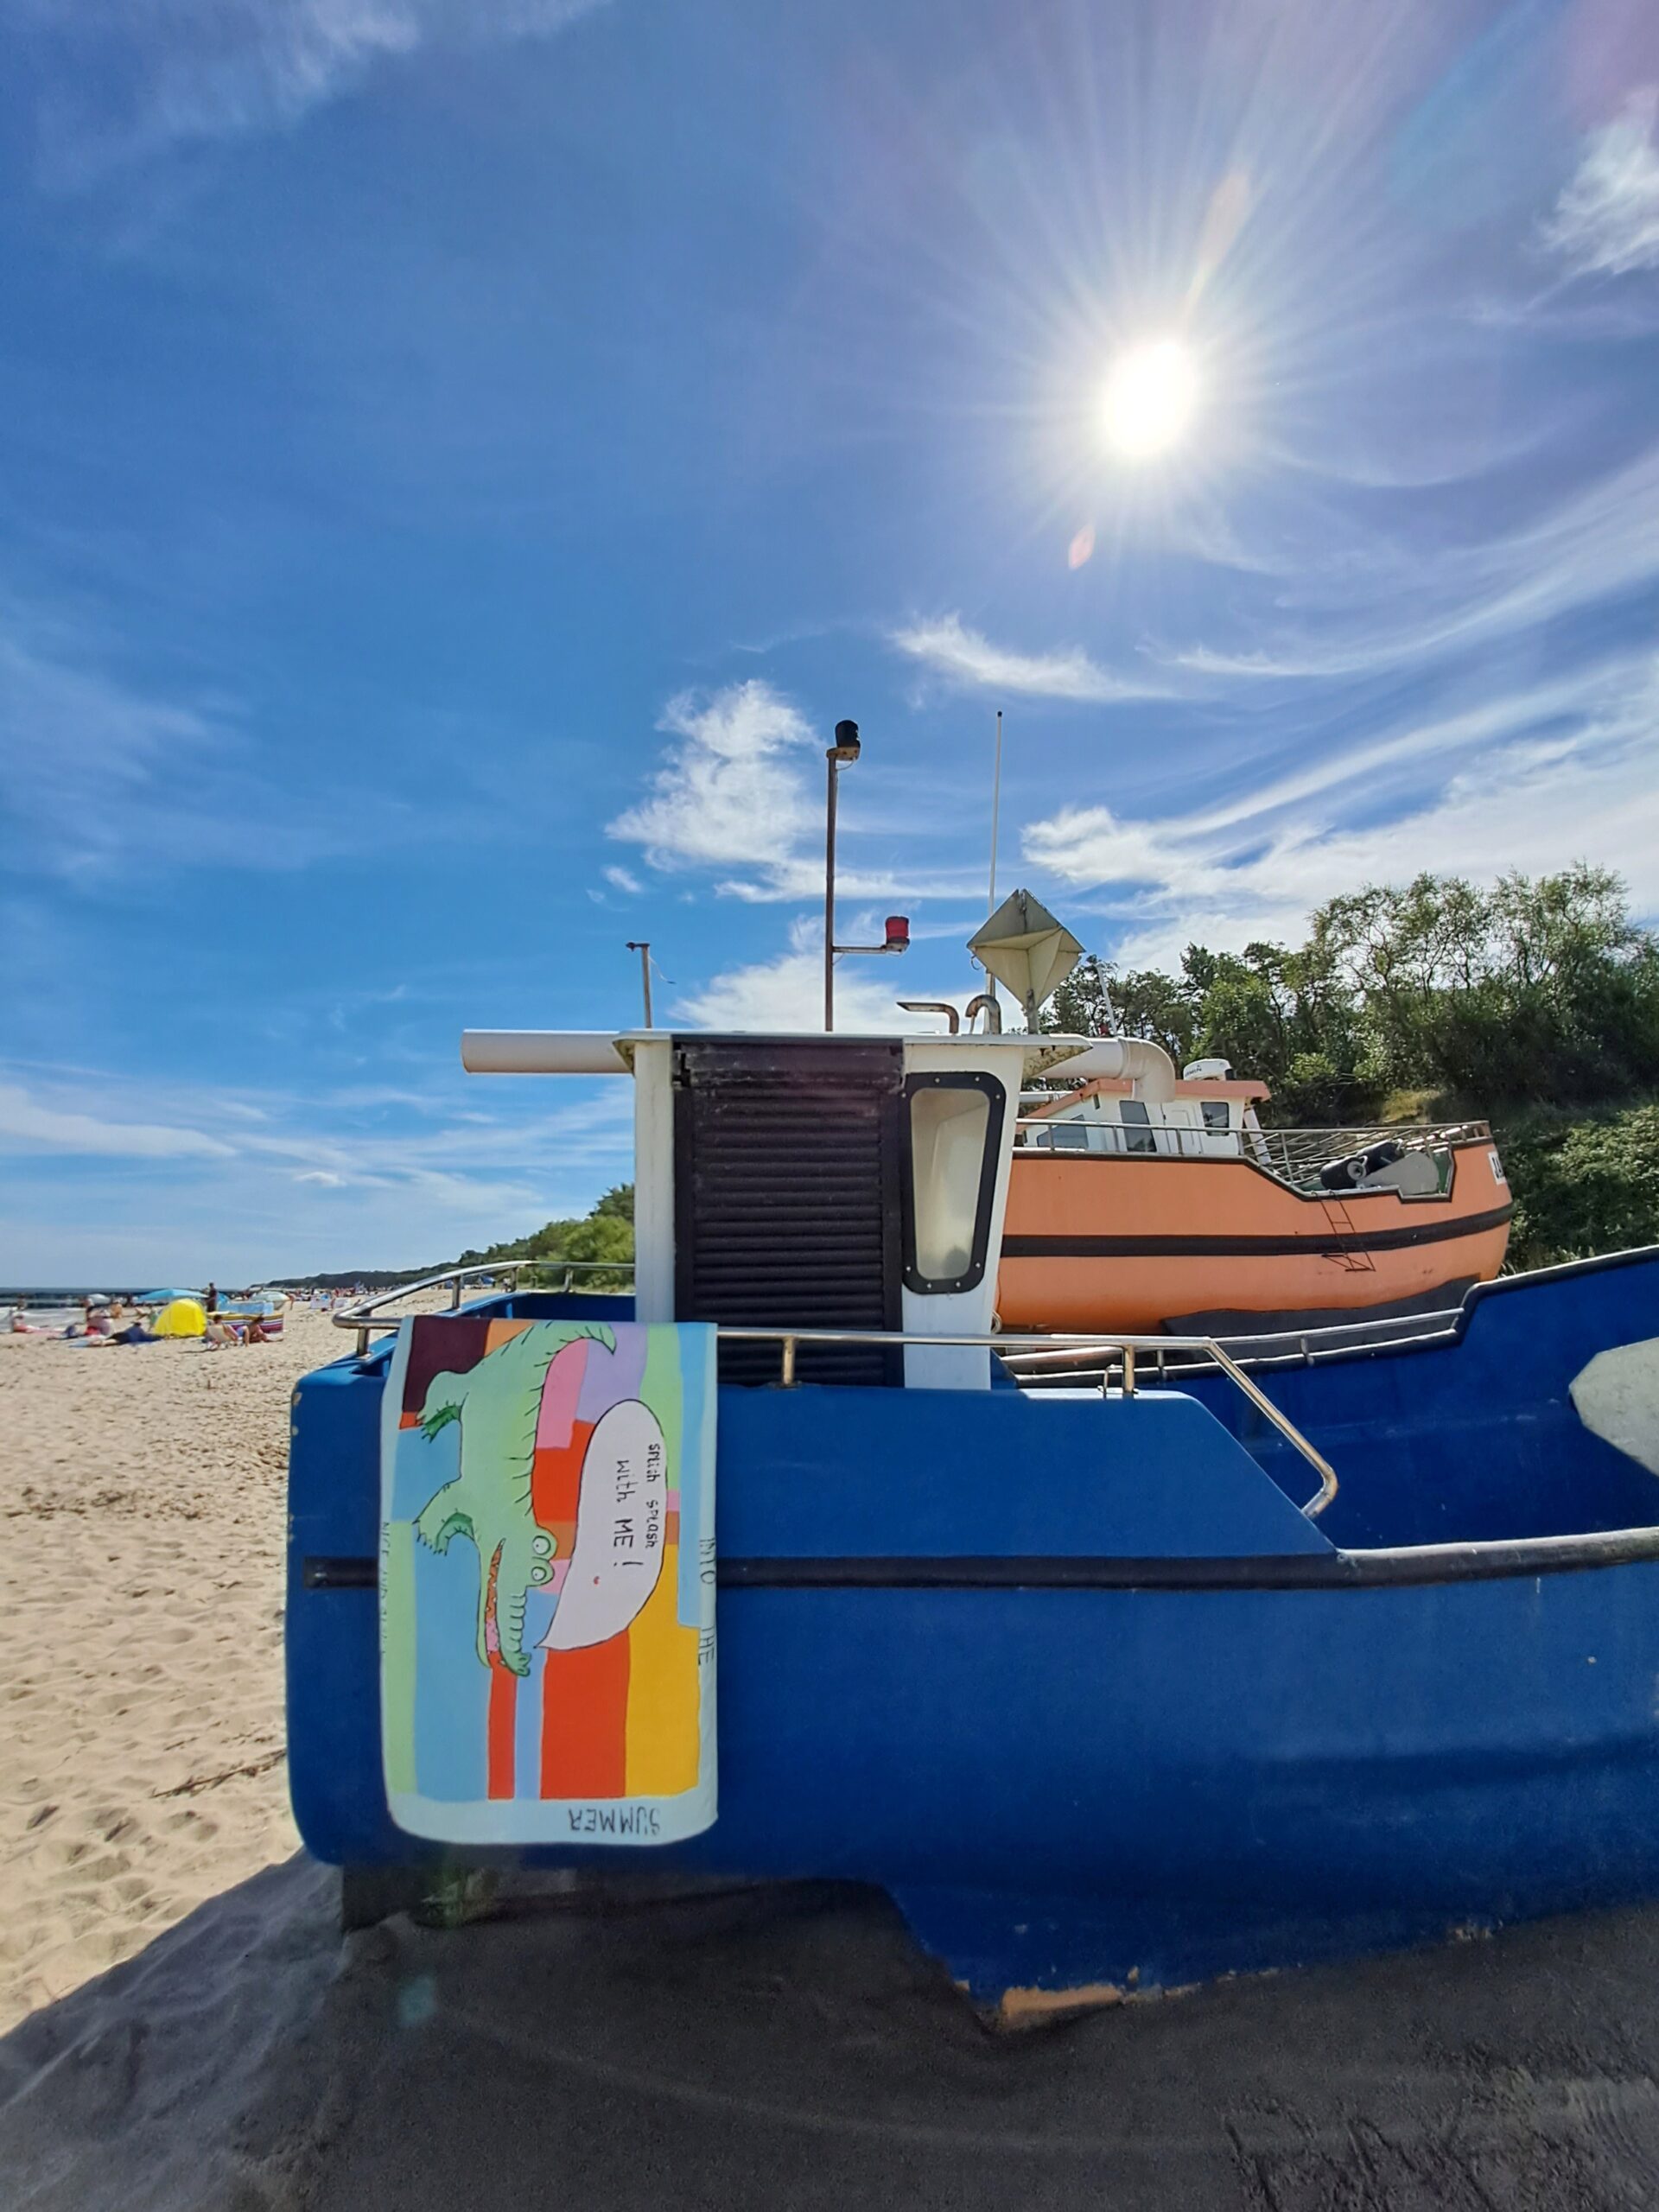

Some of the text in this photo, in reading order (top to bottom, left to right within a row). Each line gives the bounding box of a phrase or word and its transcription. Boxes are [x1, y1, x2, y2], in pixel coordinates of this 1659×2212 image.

[616, 1459, 639, 1503] with
[613, 1518, 634, 1548] ME
[697, 1538, 717, 1666] INTO THE
[569, 1806, 660, 1836] SUMMER
